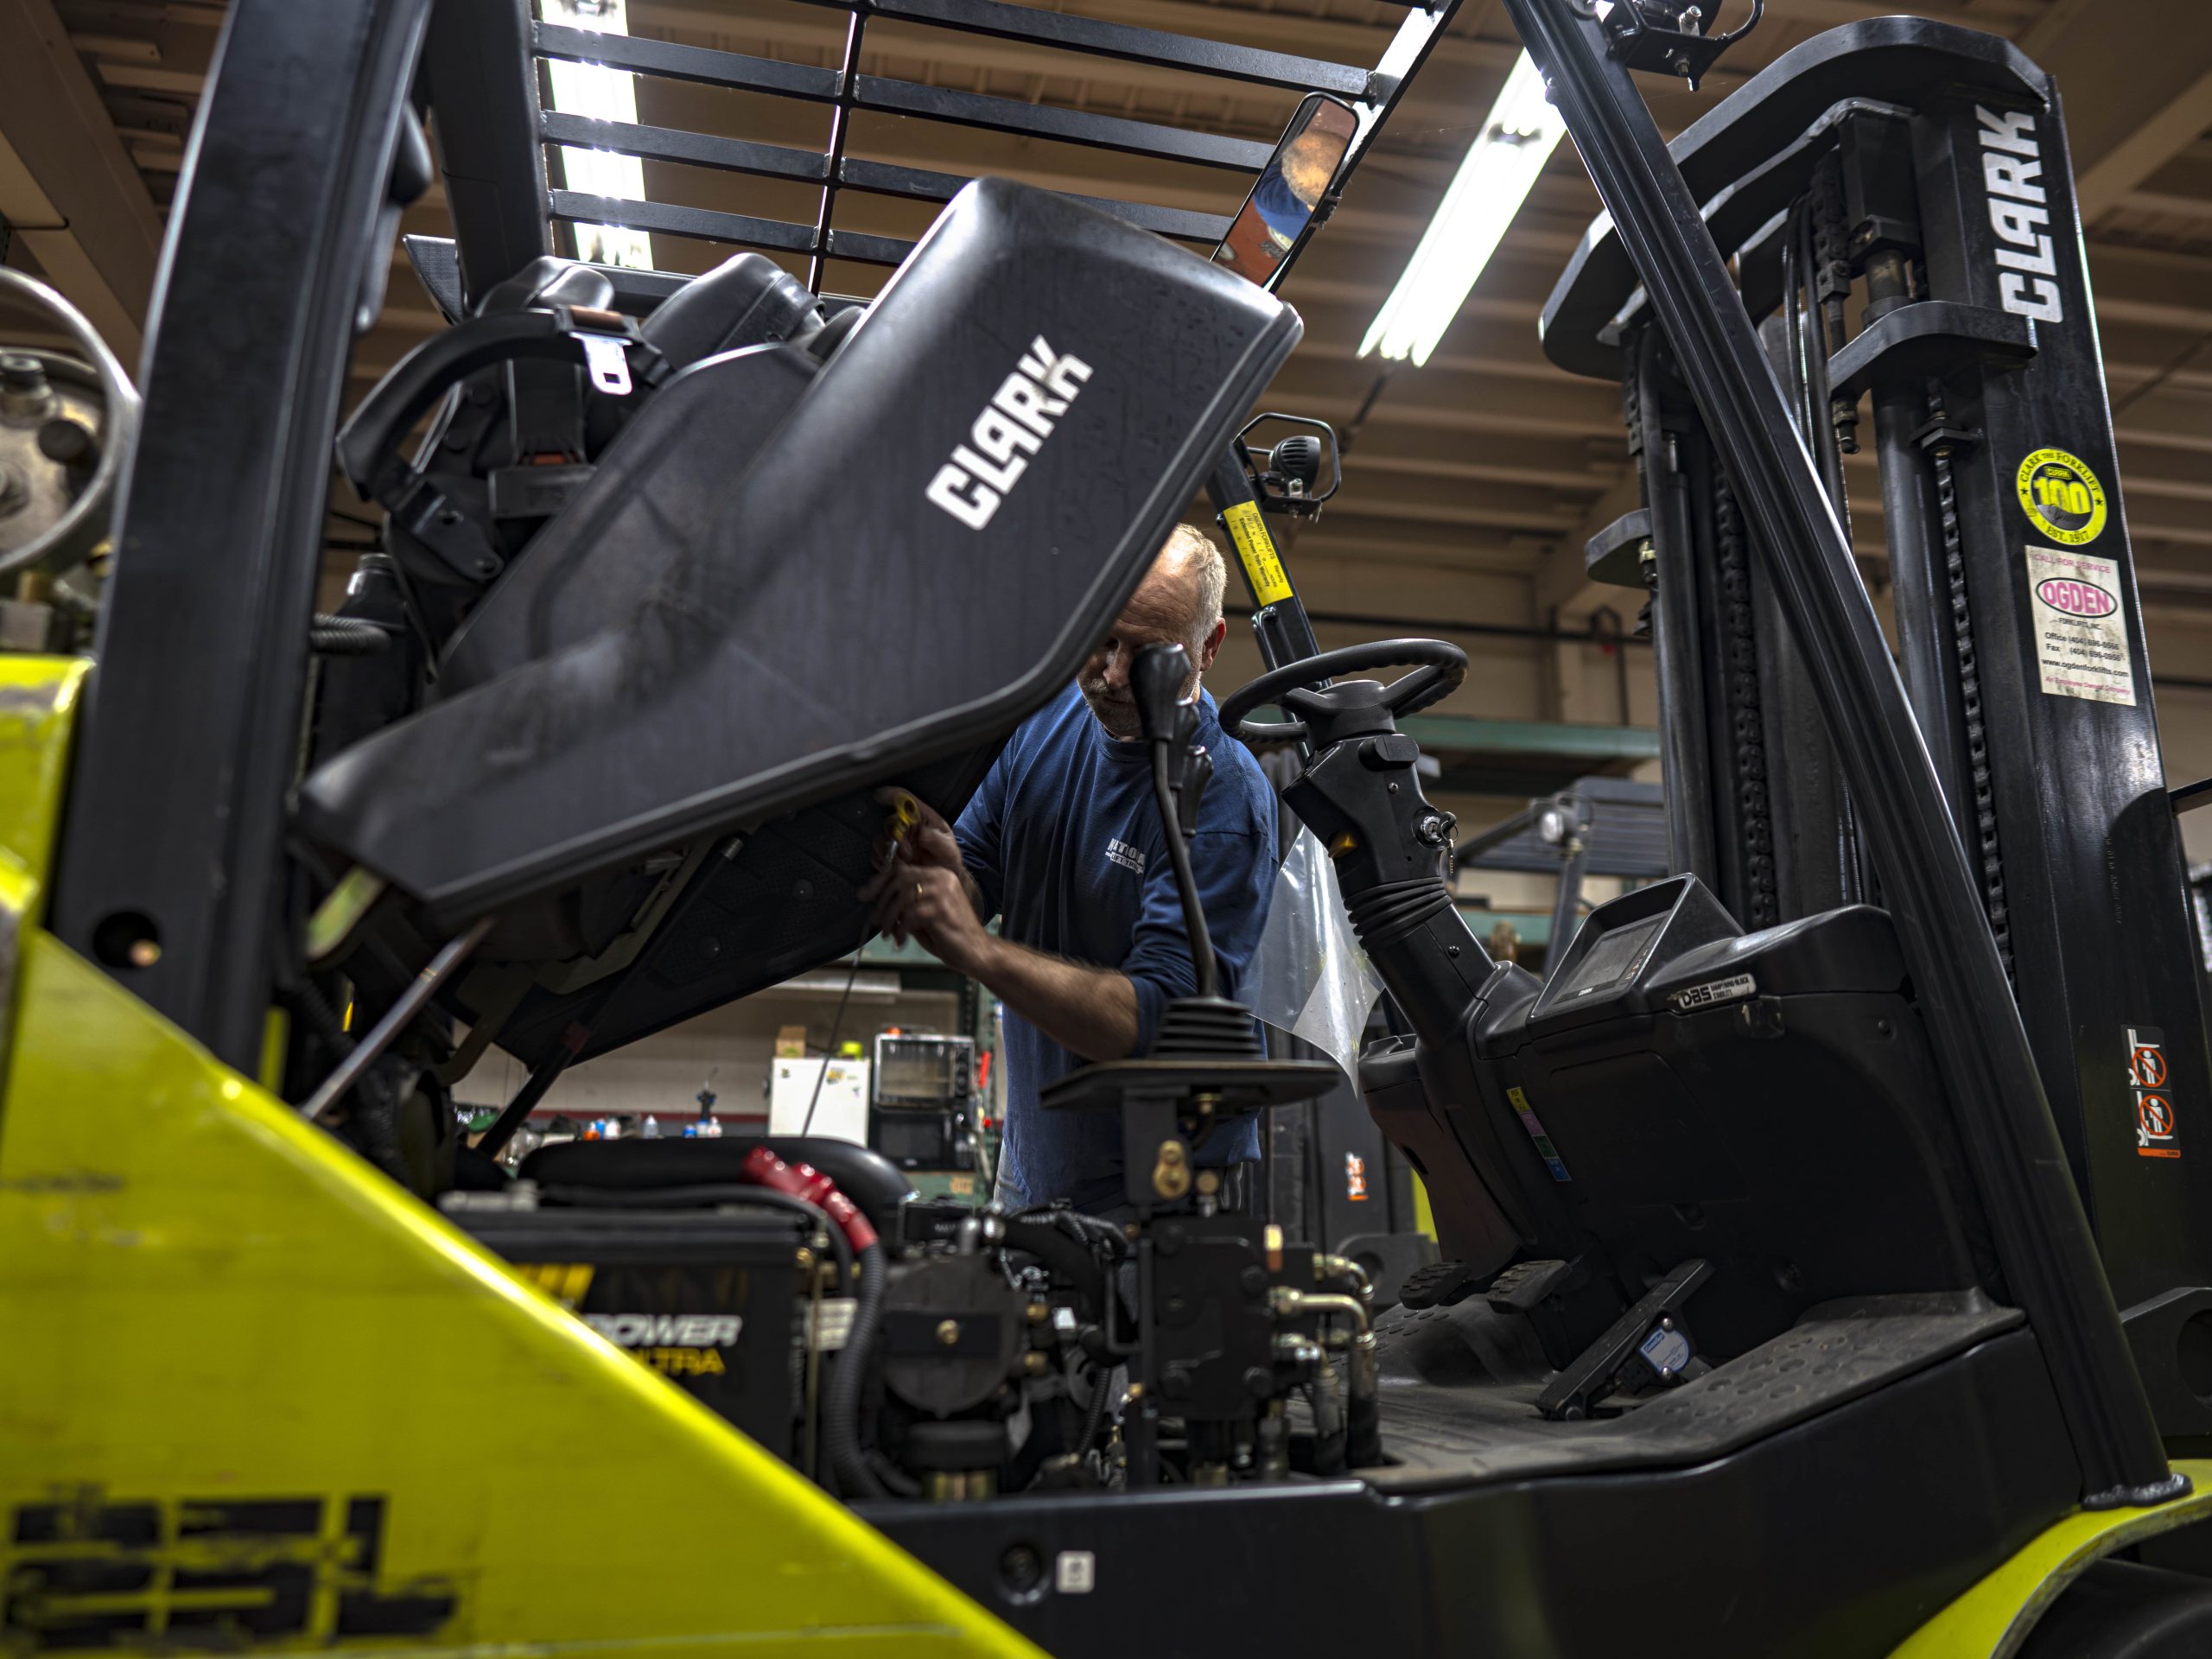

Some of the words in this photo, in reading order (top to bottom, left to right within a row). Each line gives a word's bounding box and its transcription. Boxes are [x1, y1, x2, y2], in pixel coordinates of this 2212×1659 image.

[1975, 104, 2063, 323] CLARK
[925, 334, 1093, 531] CLARK
[2020, 454, 2043, 482] CLARK
[2056, 453, 2100, 492] FORKLIFT
[2033, 477, 2091, 513] 100
[1252, 512, 1264, 531] OGDEN
[1260, 531, 1275, 559] FORKLIFTS
[2046, 526, 2067, 541] EST.
[2069, 531, 2089, 543] 1917
[1238, 518, 1251, 539] Extended
[1257, 566, 1271, 587] Warranty
[2056, 557, 2075, 567] FOR
[2075, 560, 2111, 573] SERVICE
[2043, 582, 2110, 613] OGDEN
[2044, 632, 2067, 641] Office
[2045, 643, 2060, 652] Fax
[2069, 646, 2088, 658] (404)
[2041, 659, 2129, 677] www.ogdenforklifts.com
